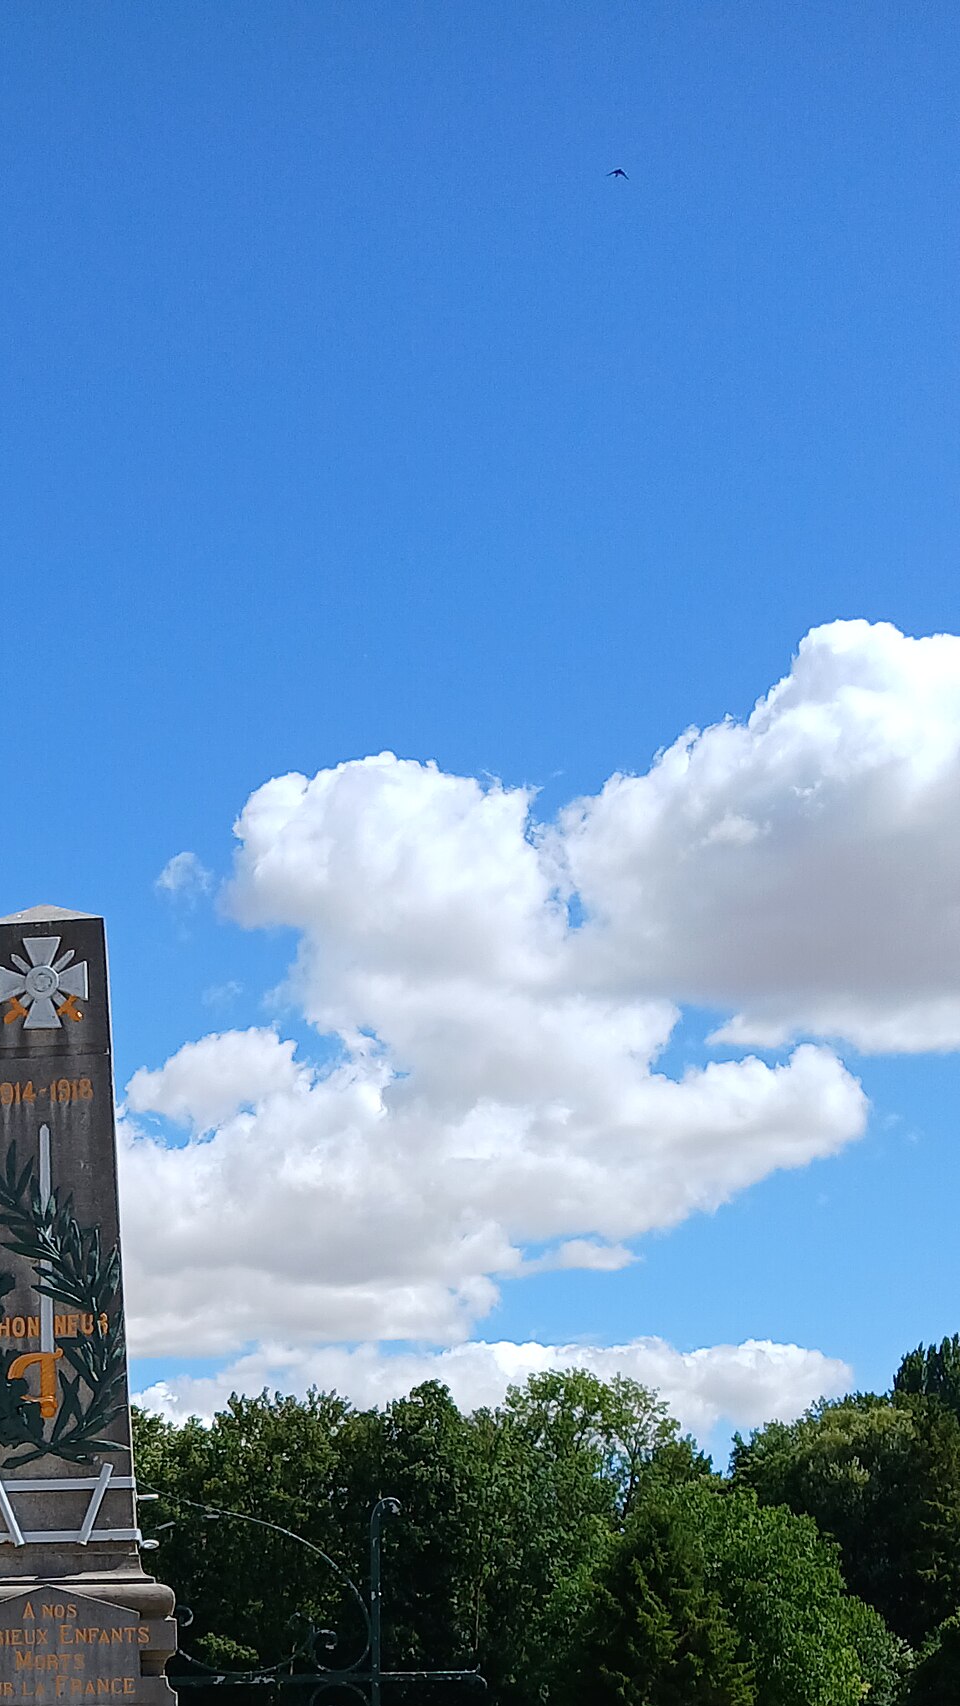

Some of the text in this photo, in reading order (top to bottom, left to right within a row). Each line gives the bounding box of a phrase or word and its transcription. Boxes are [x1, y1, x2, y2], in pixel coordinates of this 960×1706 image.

[23, 1601, 77, 1619] A NOS
[59, 1625, 150, 1644] ENFANTS
[15, 1651, 86, 1671] MORTS
[22, 1683, 44, 1696] LA
[55, 1676, 136, 1697] FRANCE
